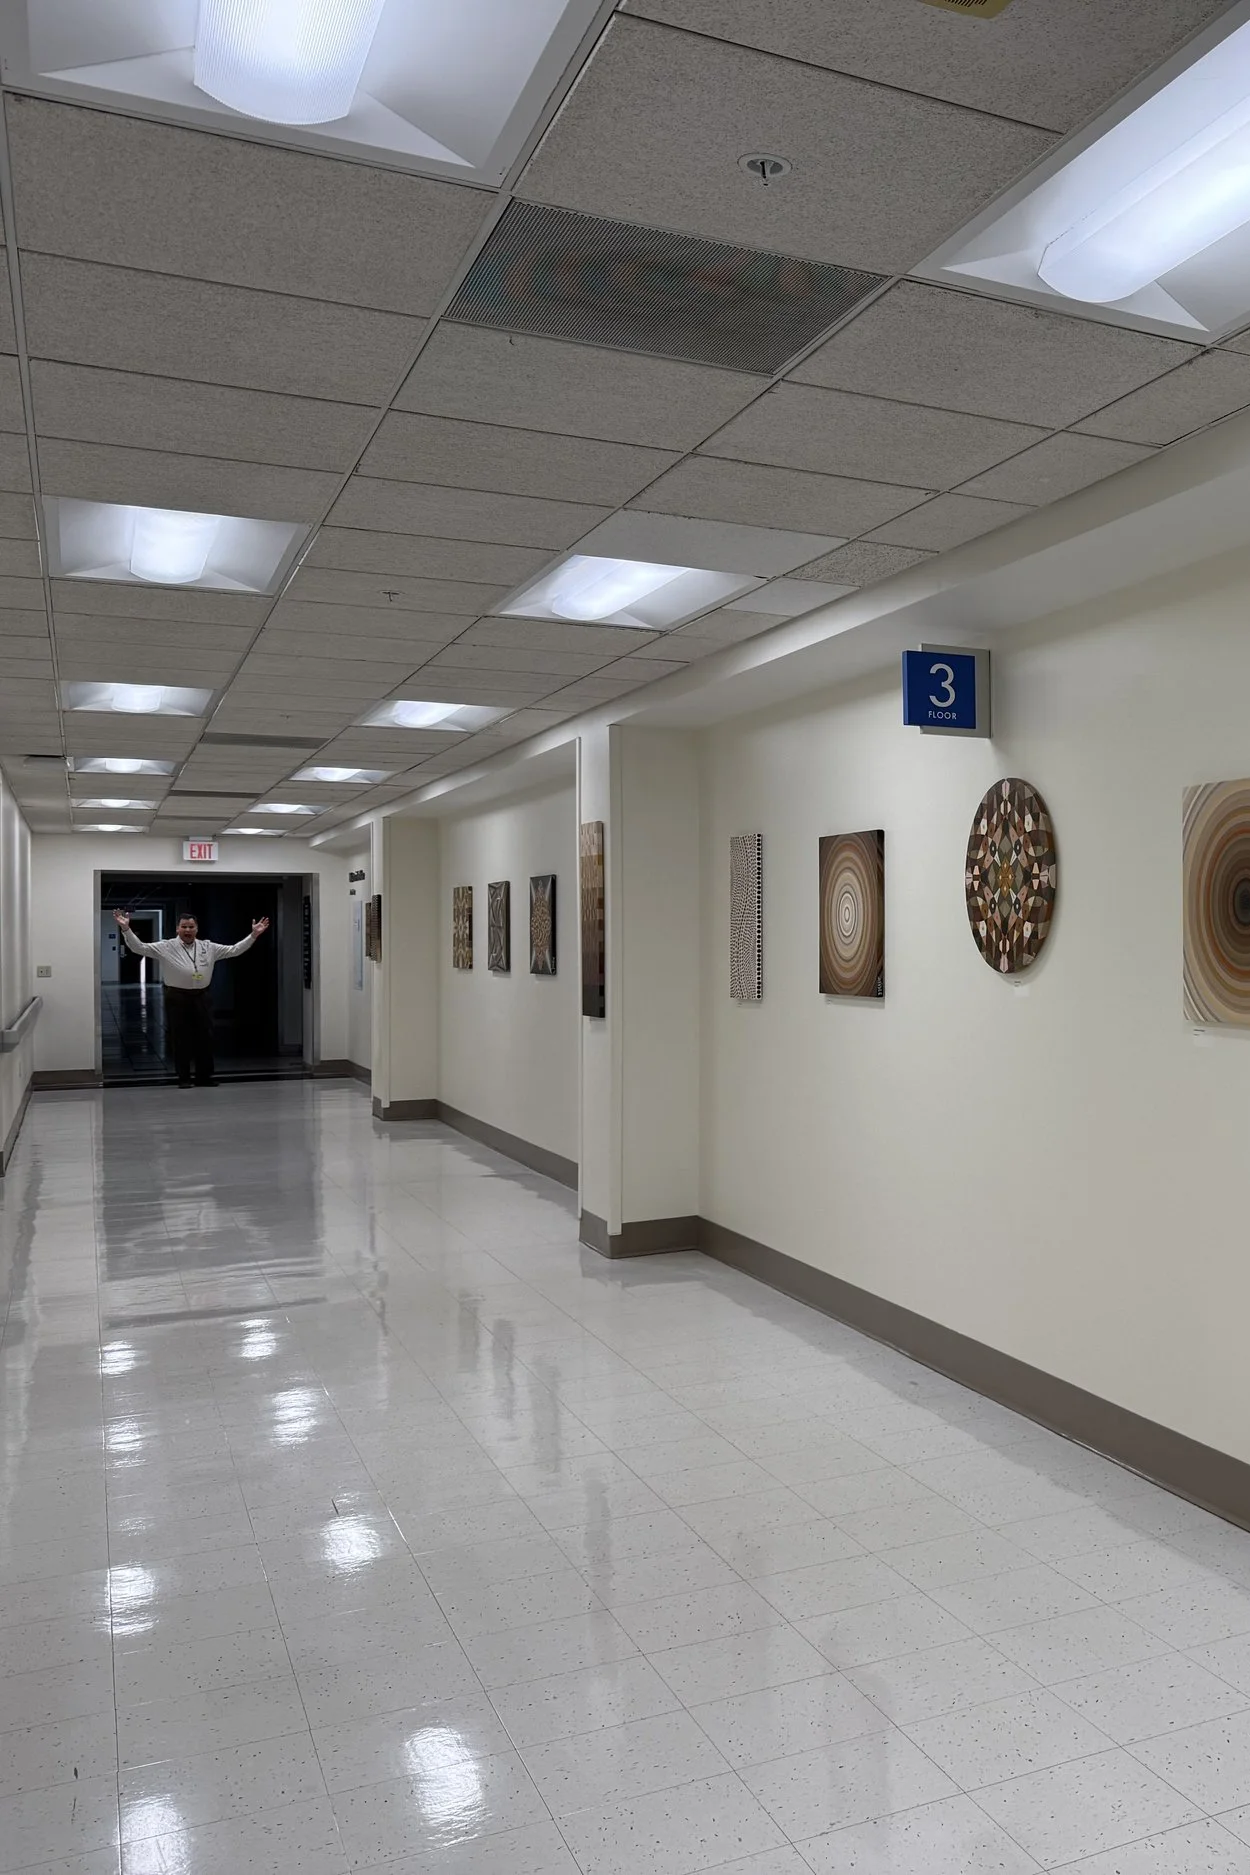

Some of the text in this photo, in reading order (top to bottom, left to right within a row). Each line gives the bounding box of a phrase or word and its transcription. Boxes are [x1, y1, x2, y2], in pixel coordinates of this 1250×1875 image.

[929, 663, 956, 708] 3
[928, 710, 957, 720] FLOOR
[190, 843, 213, 859] EXIT
